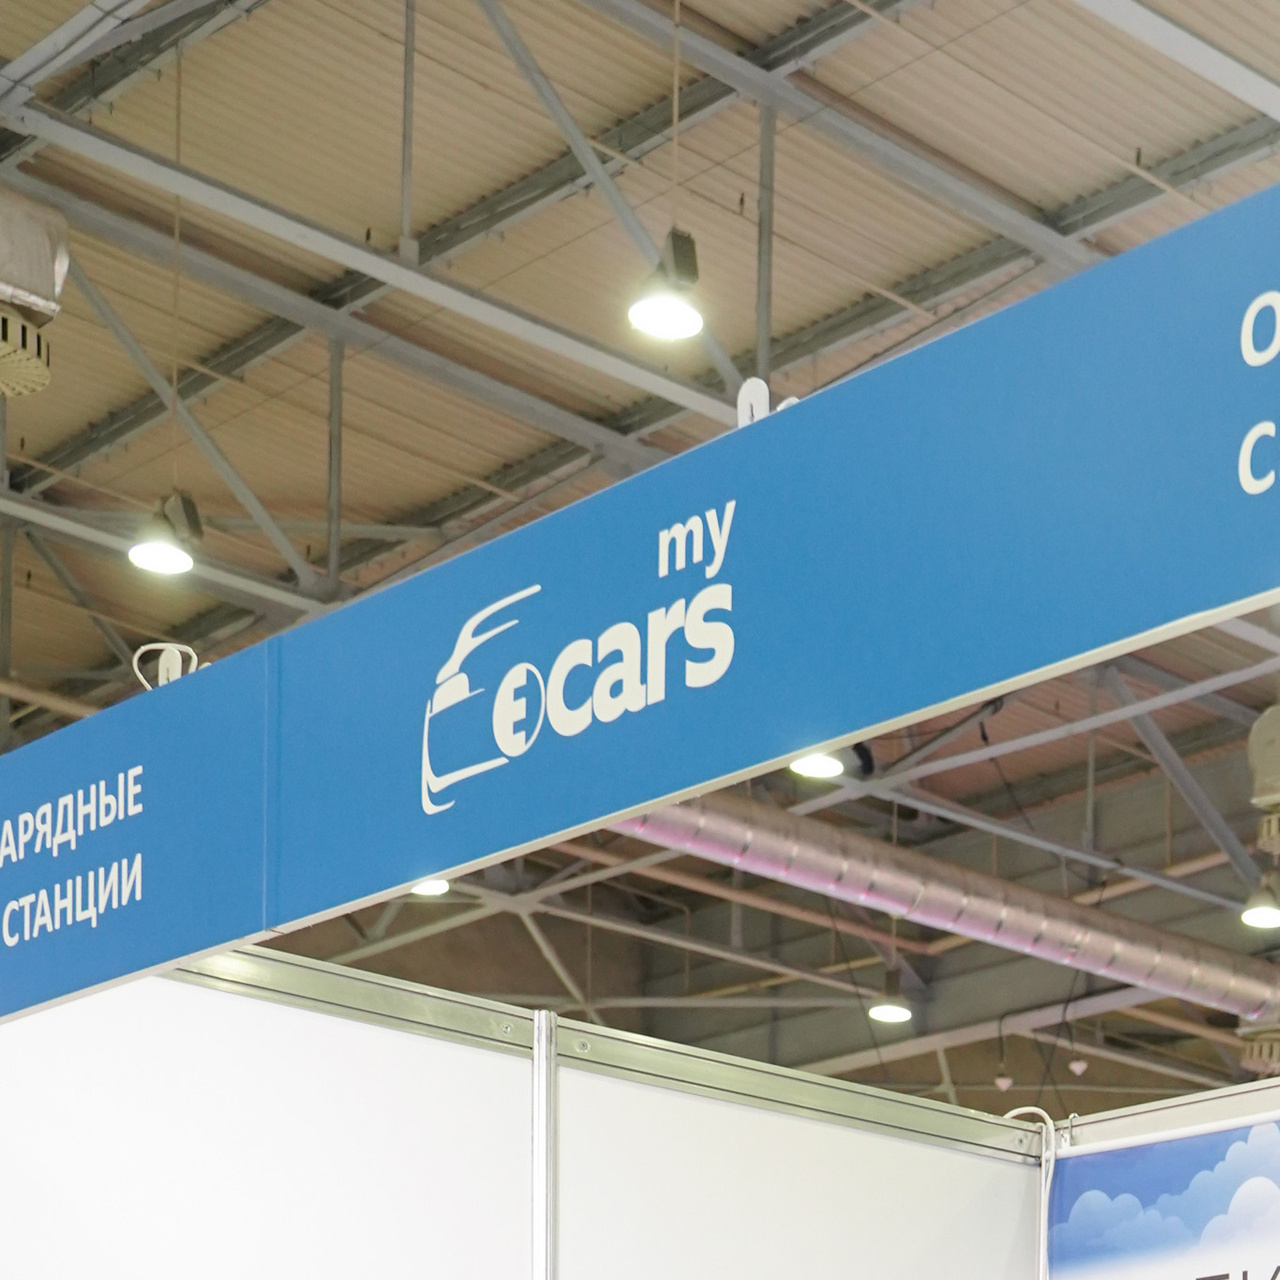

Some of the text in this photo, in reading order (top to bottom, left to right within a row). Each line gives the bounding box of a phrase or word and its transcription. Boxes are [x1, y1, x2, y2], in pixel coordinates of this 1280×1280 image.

[658, 499, 736, 579] my
[0, 765, 143, 867] АРЯДНЫЕ
[2, 853, 143, 947] СТАНЦИИ
